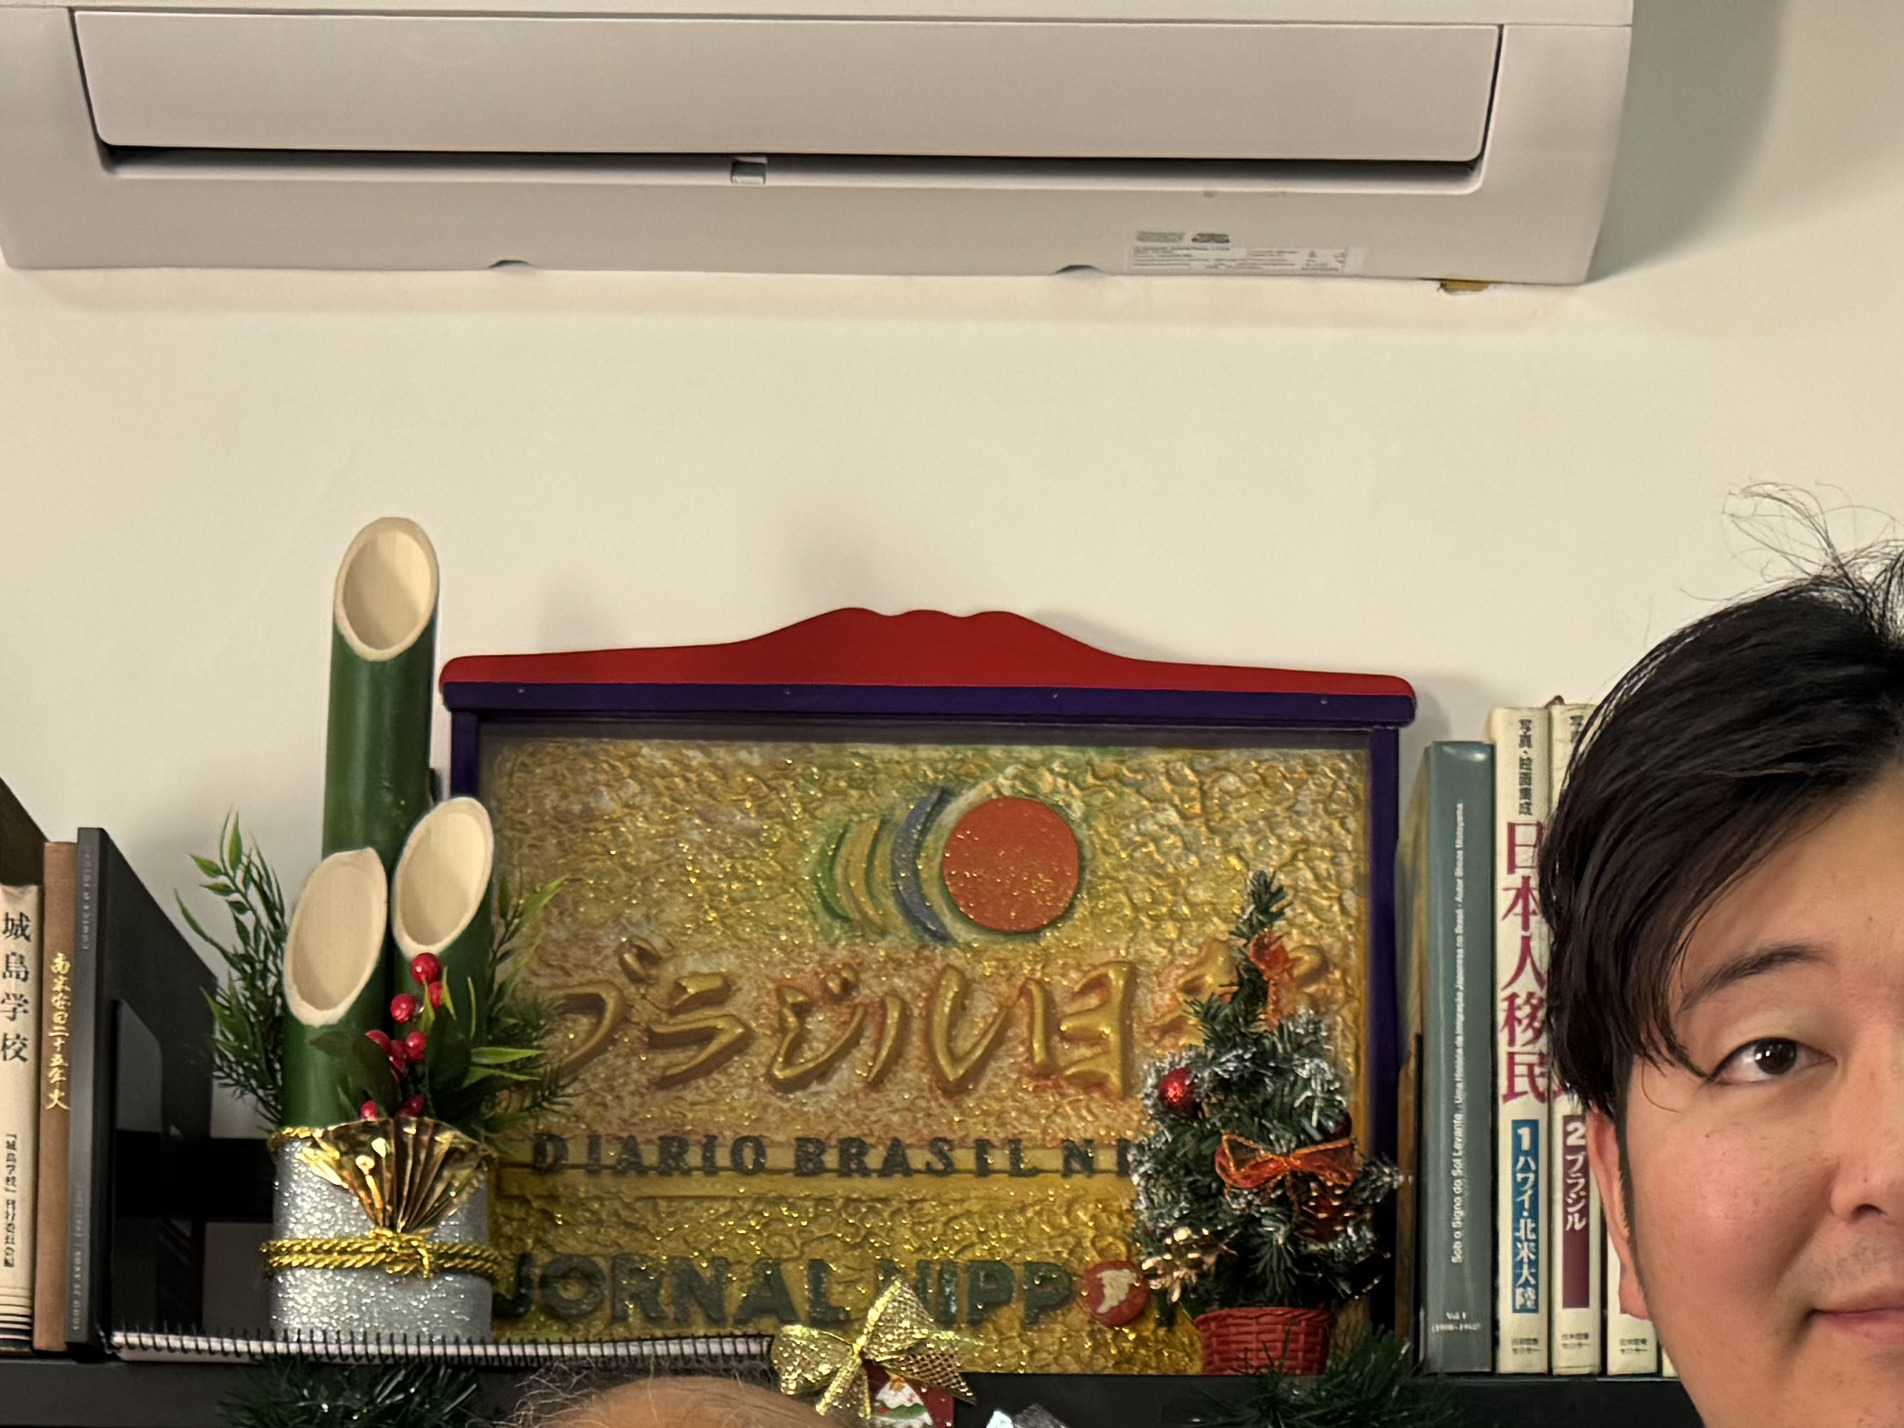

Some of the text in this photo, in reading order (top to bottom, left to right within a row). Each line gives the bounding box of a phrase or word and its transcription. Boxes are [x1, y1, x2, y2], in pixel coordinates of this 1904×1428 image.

[0, 911, 32, 1065] 城島学校
[532, 1132, 1046, 1183] DIARIO BRASIL
[1564, 1152, 1587, 1232] ブラジル
[1515, 1127, 1537, 1310] 1 ハワイ・北米大陸
[494, 1256, 846, 1325] JORNAL
